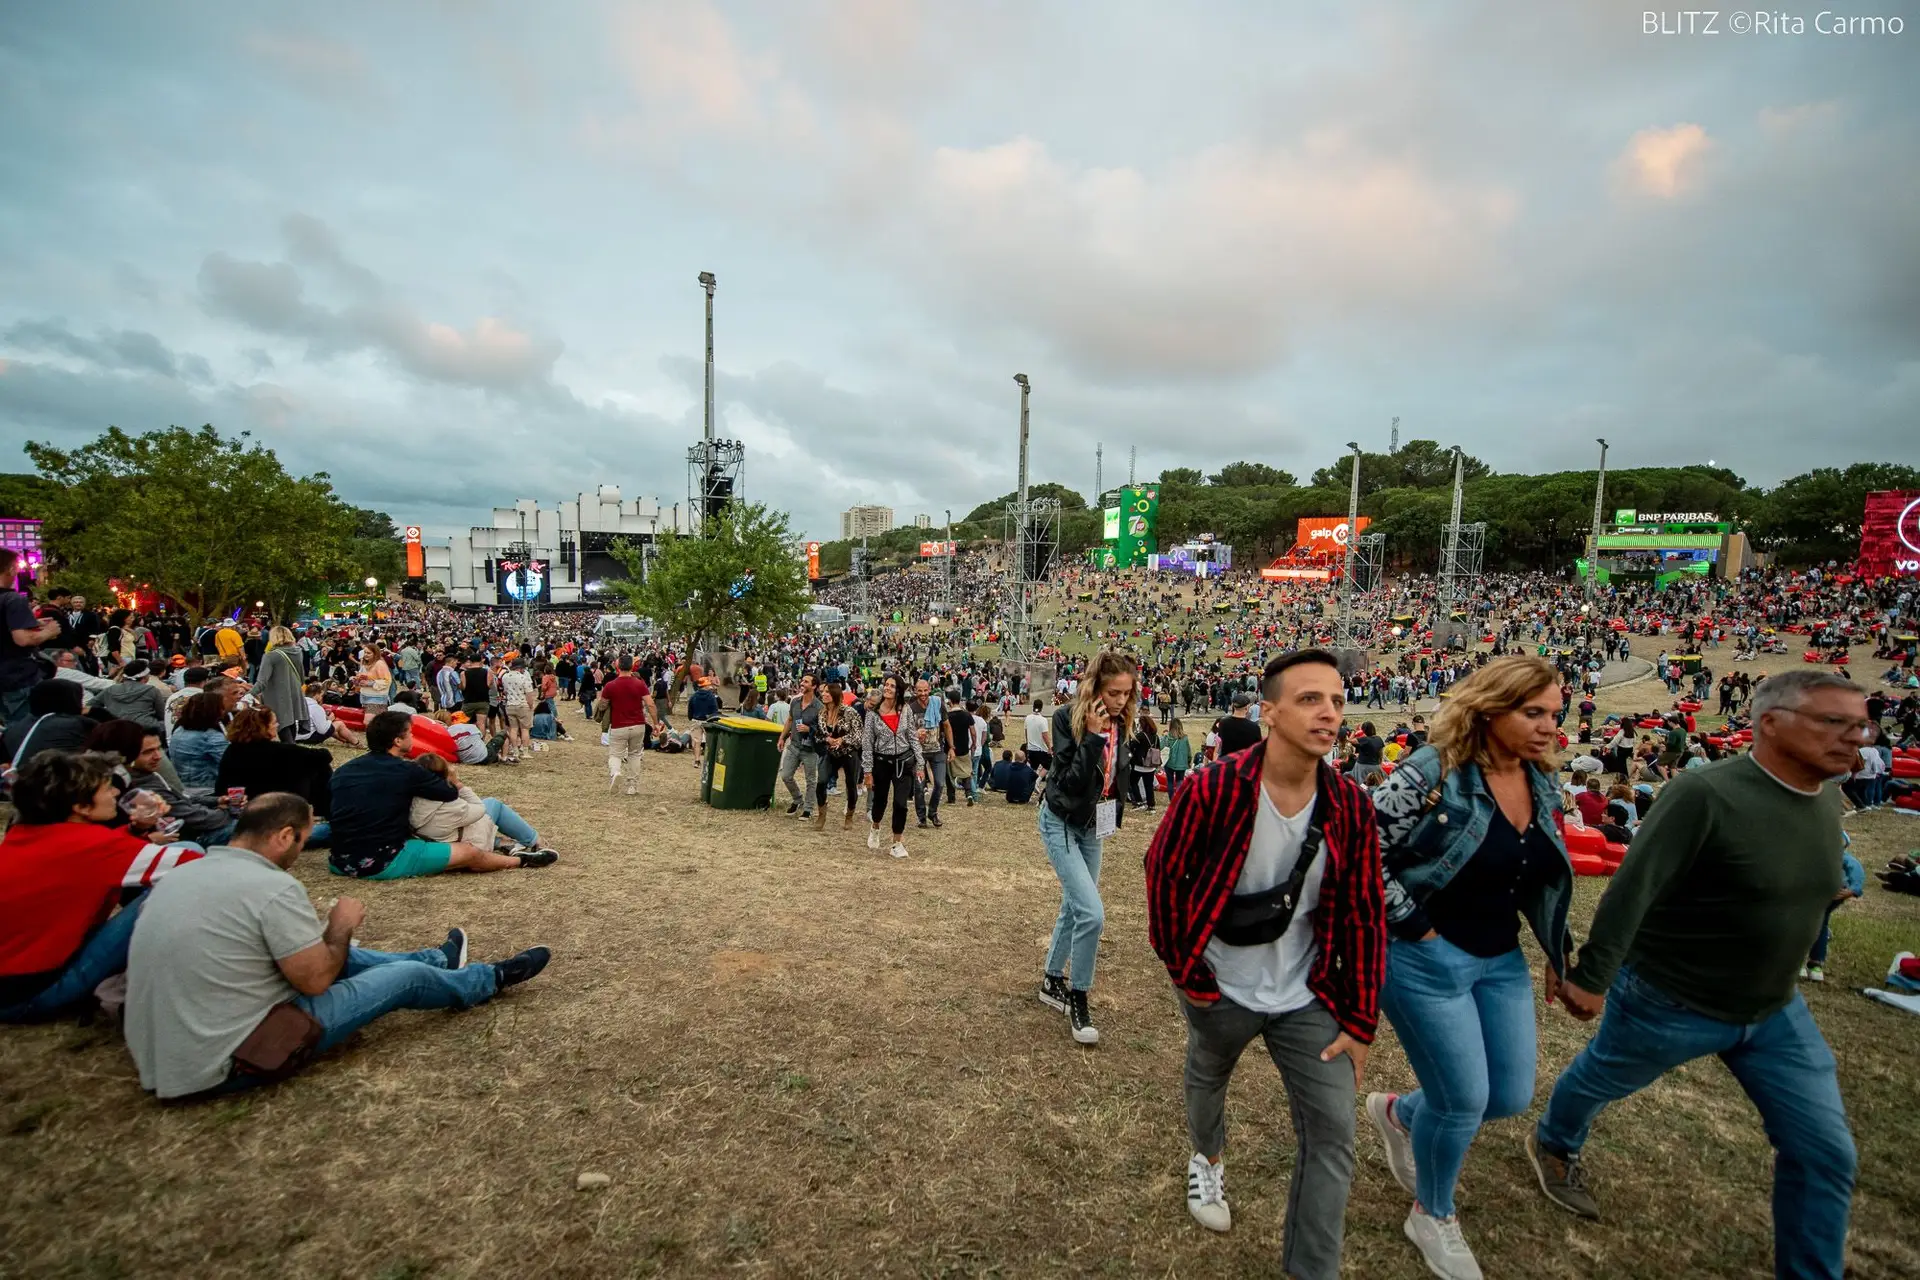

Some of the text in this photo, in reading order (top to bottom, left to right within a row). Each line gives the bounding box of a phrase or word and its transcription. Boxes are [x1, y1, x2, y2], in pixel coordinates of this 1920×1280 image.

[1638, 512, 1713, 521] BNP PARIBAS
[1310, 528, 1332, 539] galp
